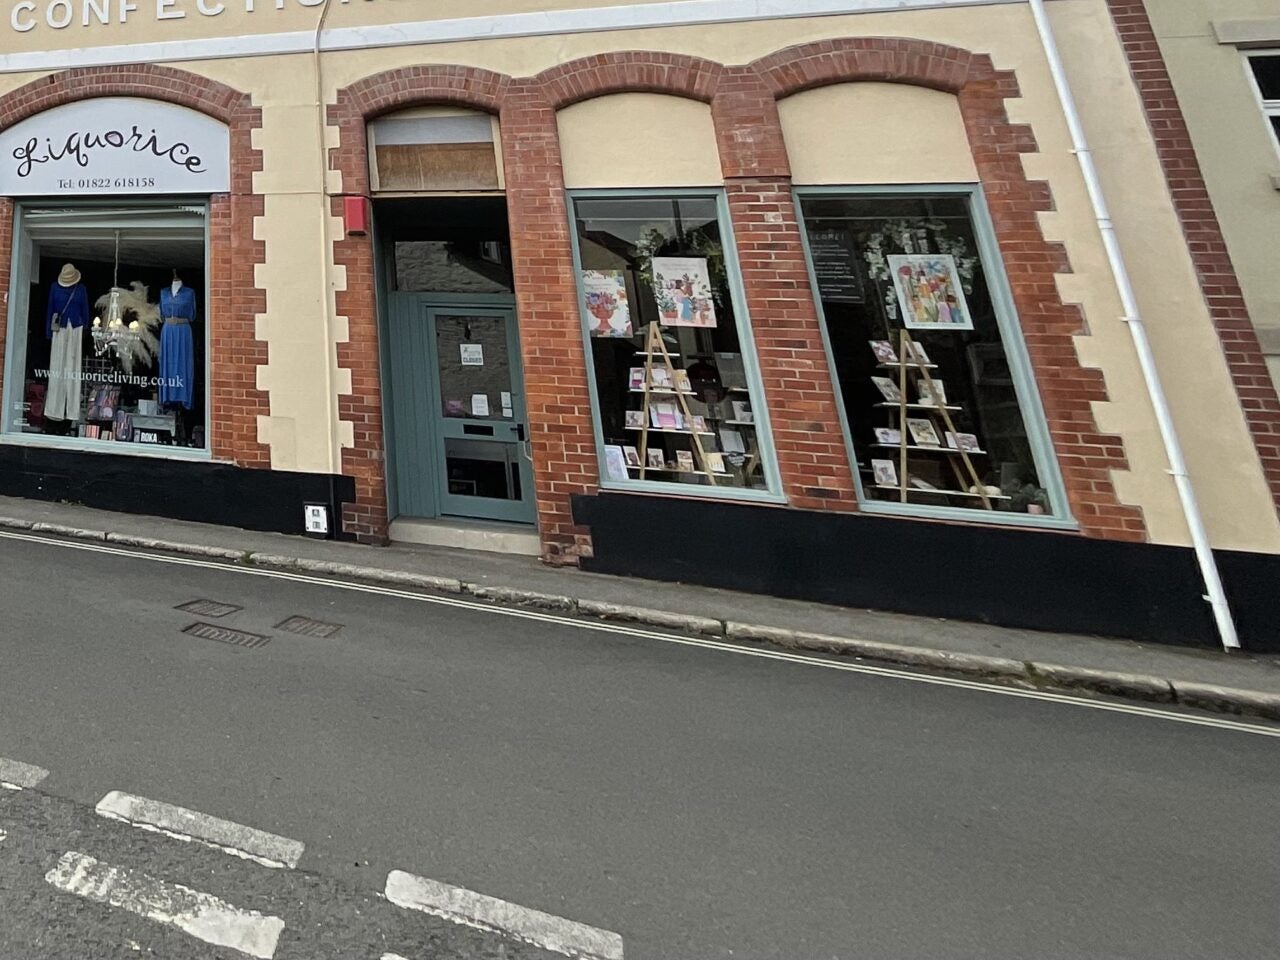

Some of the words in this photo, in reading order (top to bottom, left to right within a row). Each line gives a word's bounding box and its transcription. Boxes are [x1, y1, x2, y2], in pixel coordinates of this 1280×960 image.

[12, 124, 208, 178] Liquorice
[78, 178, 111, 189] 01822
[114, 177, 156, 189] 618158
